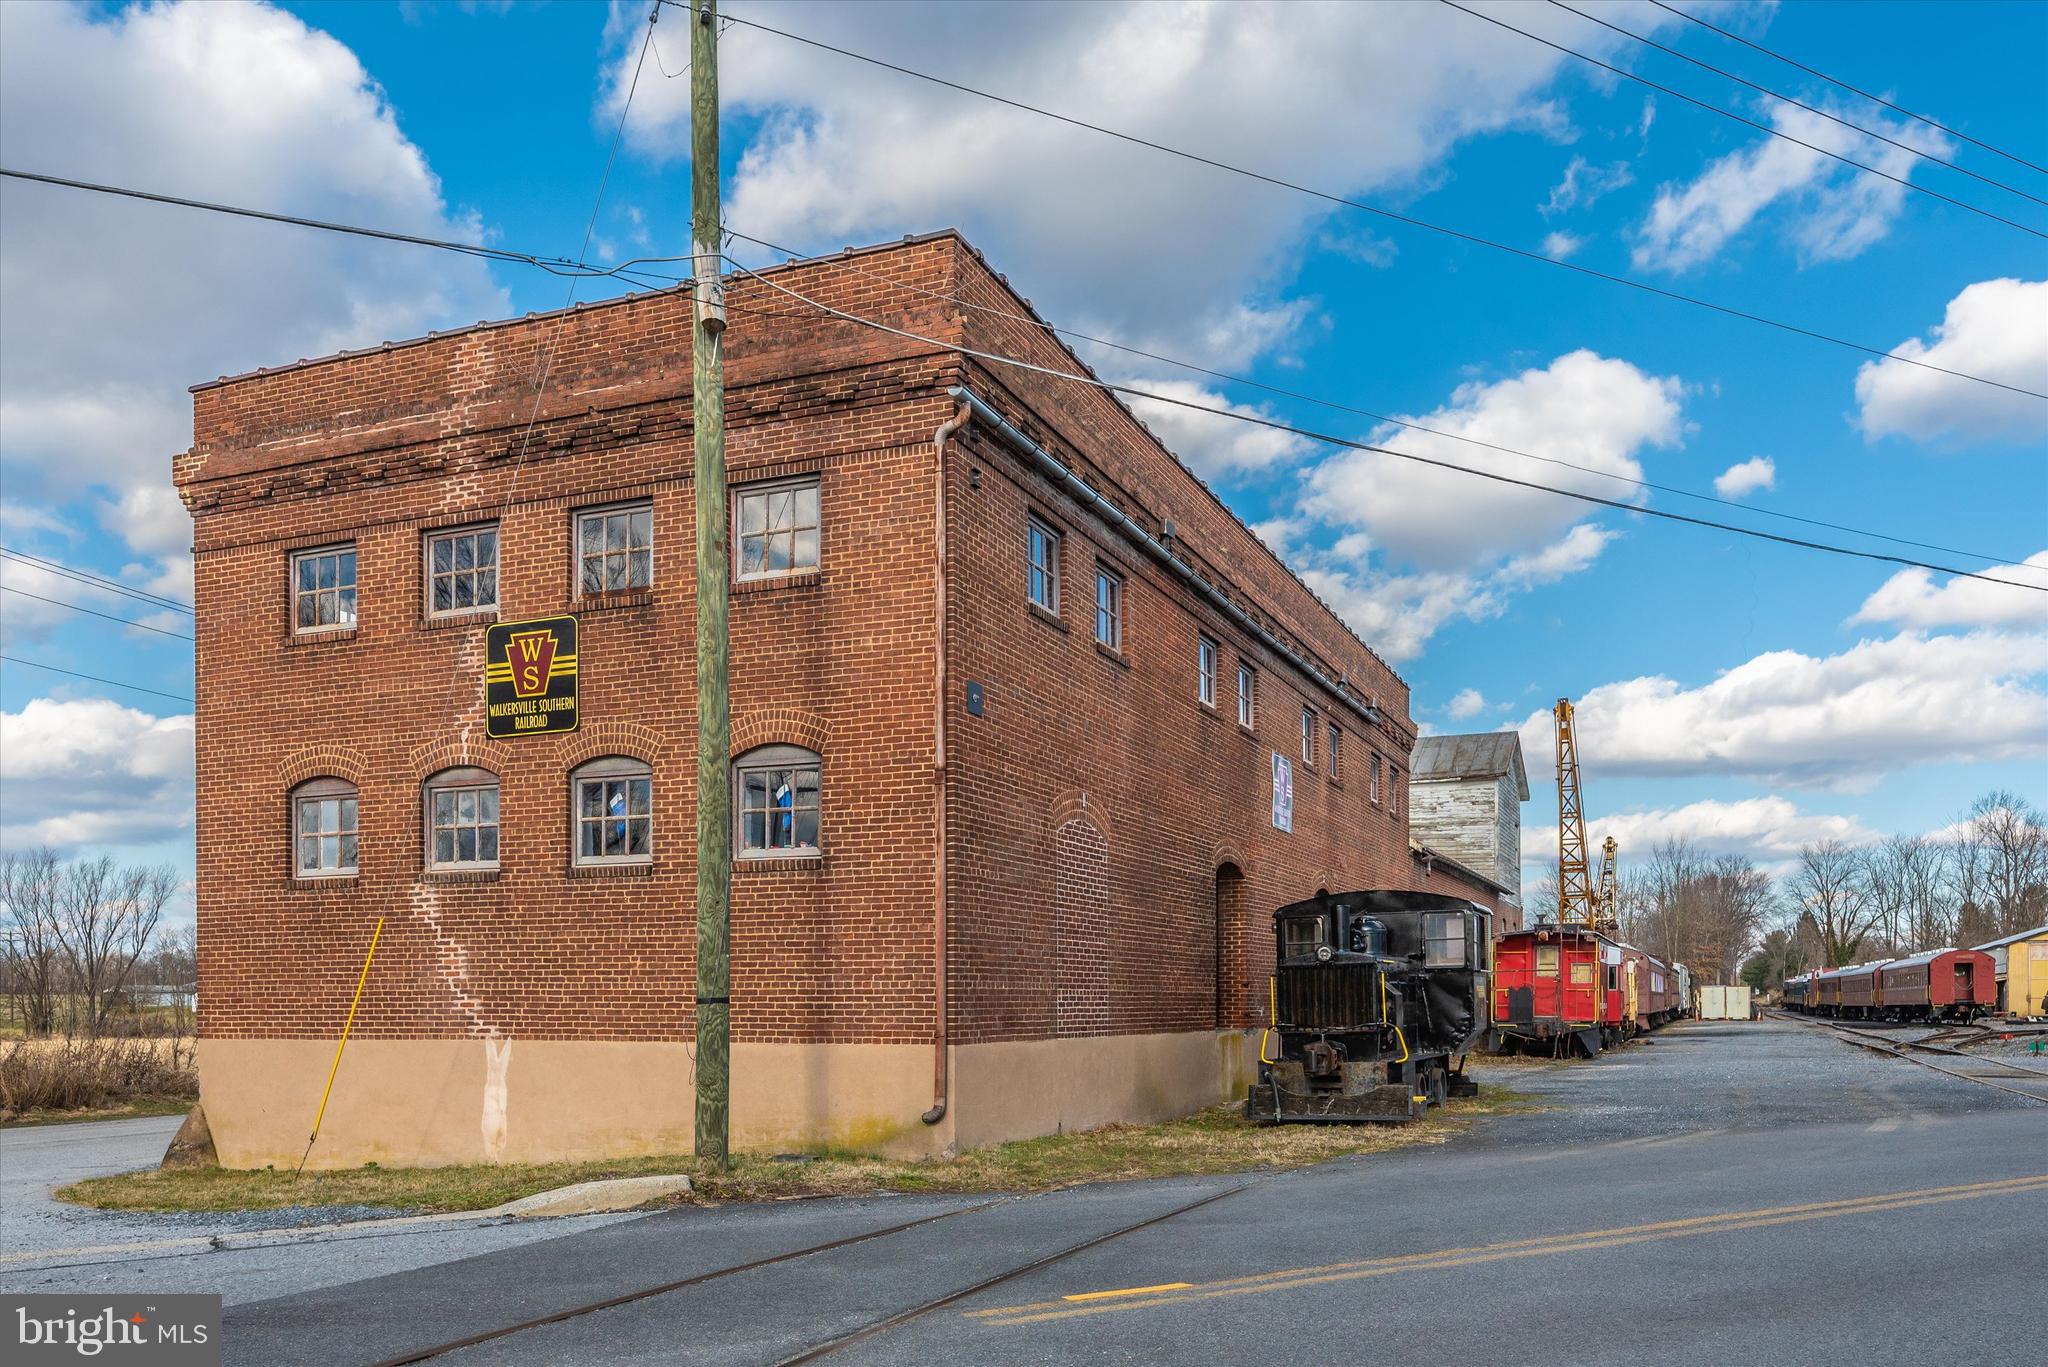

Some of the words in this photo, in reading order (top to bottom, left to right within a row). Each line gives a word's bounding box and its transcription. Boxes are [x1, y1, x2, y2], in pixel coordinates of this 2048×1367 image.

[519, 637, 544, 662] W
[523, 666, 539, 690] S
[489, 700, 537, 717] WALKERSVILLE
[539, 697, 575, 712] SOUTHERN
[515, 714, 548, 730] RAILROAD
